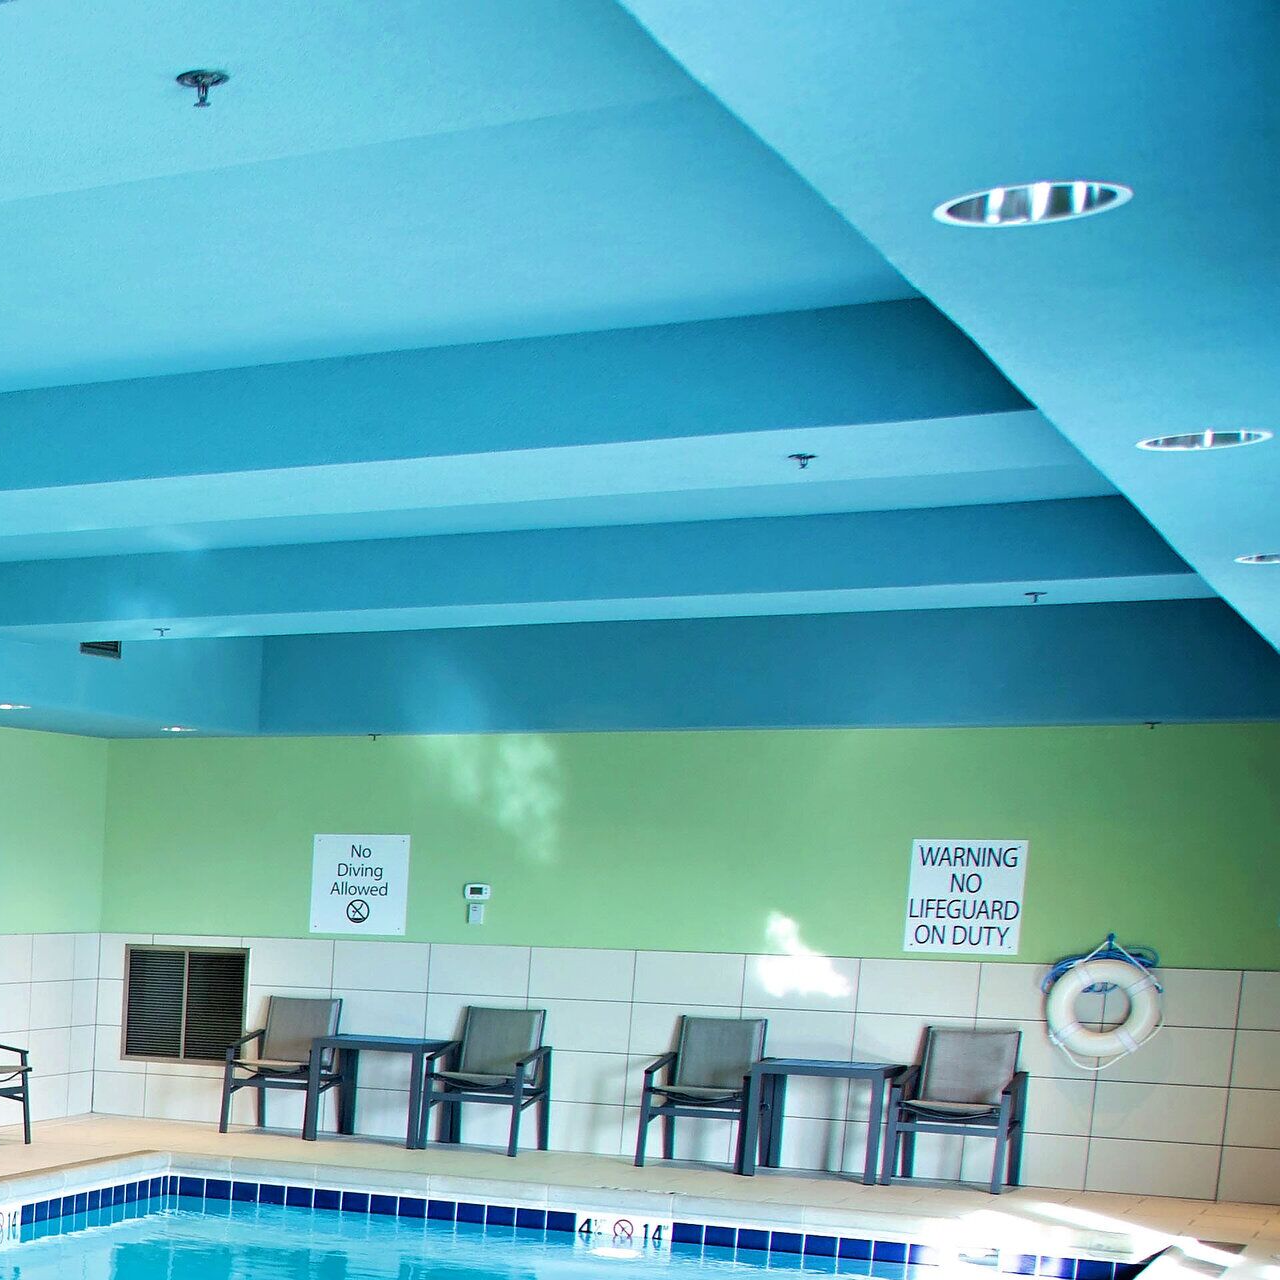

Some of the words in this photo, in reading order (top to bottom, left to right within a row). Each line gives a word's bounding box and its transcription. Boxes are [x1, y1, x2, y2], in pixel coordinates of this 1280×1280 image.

[351, 845, 372, 858] No
[920, 847, 1018, 867] WARNING
[337, 863, 383, 881] Diving
[330, 882, 388, 896] Allowed
[950, 873, 982, 893] NO
[909, 898, 1020, 920] LIFEGUARD
[914, 924, 946, 944] ON
[952, 926, 1009, 946] DUTY
